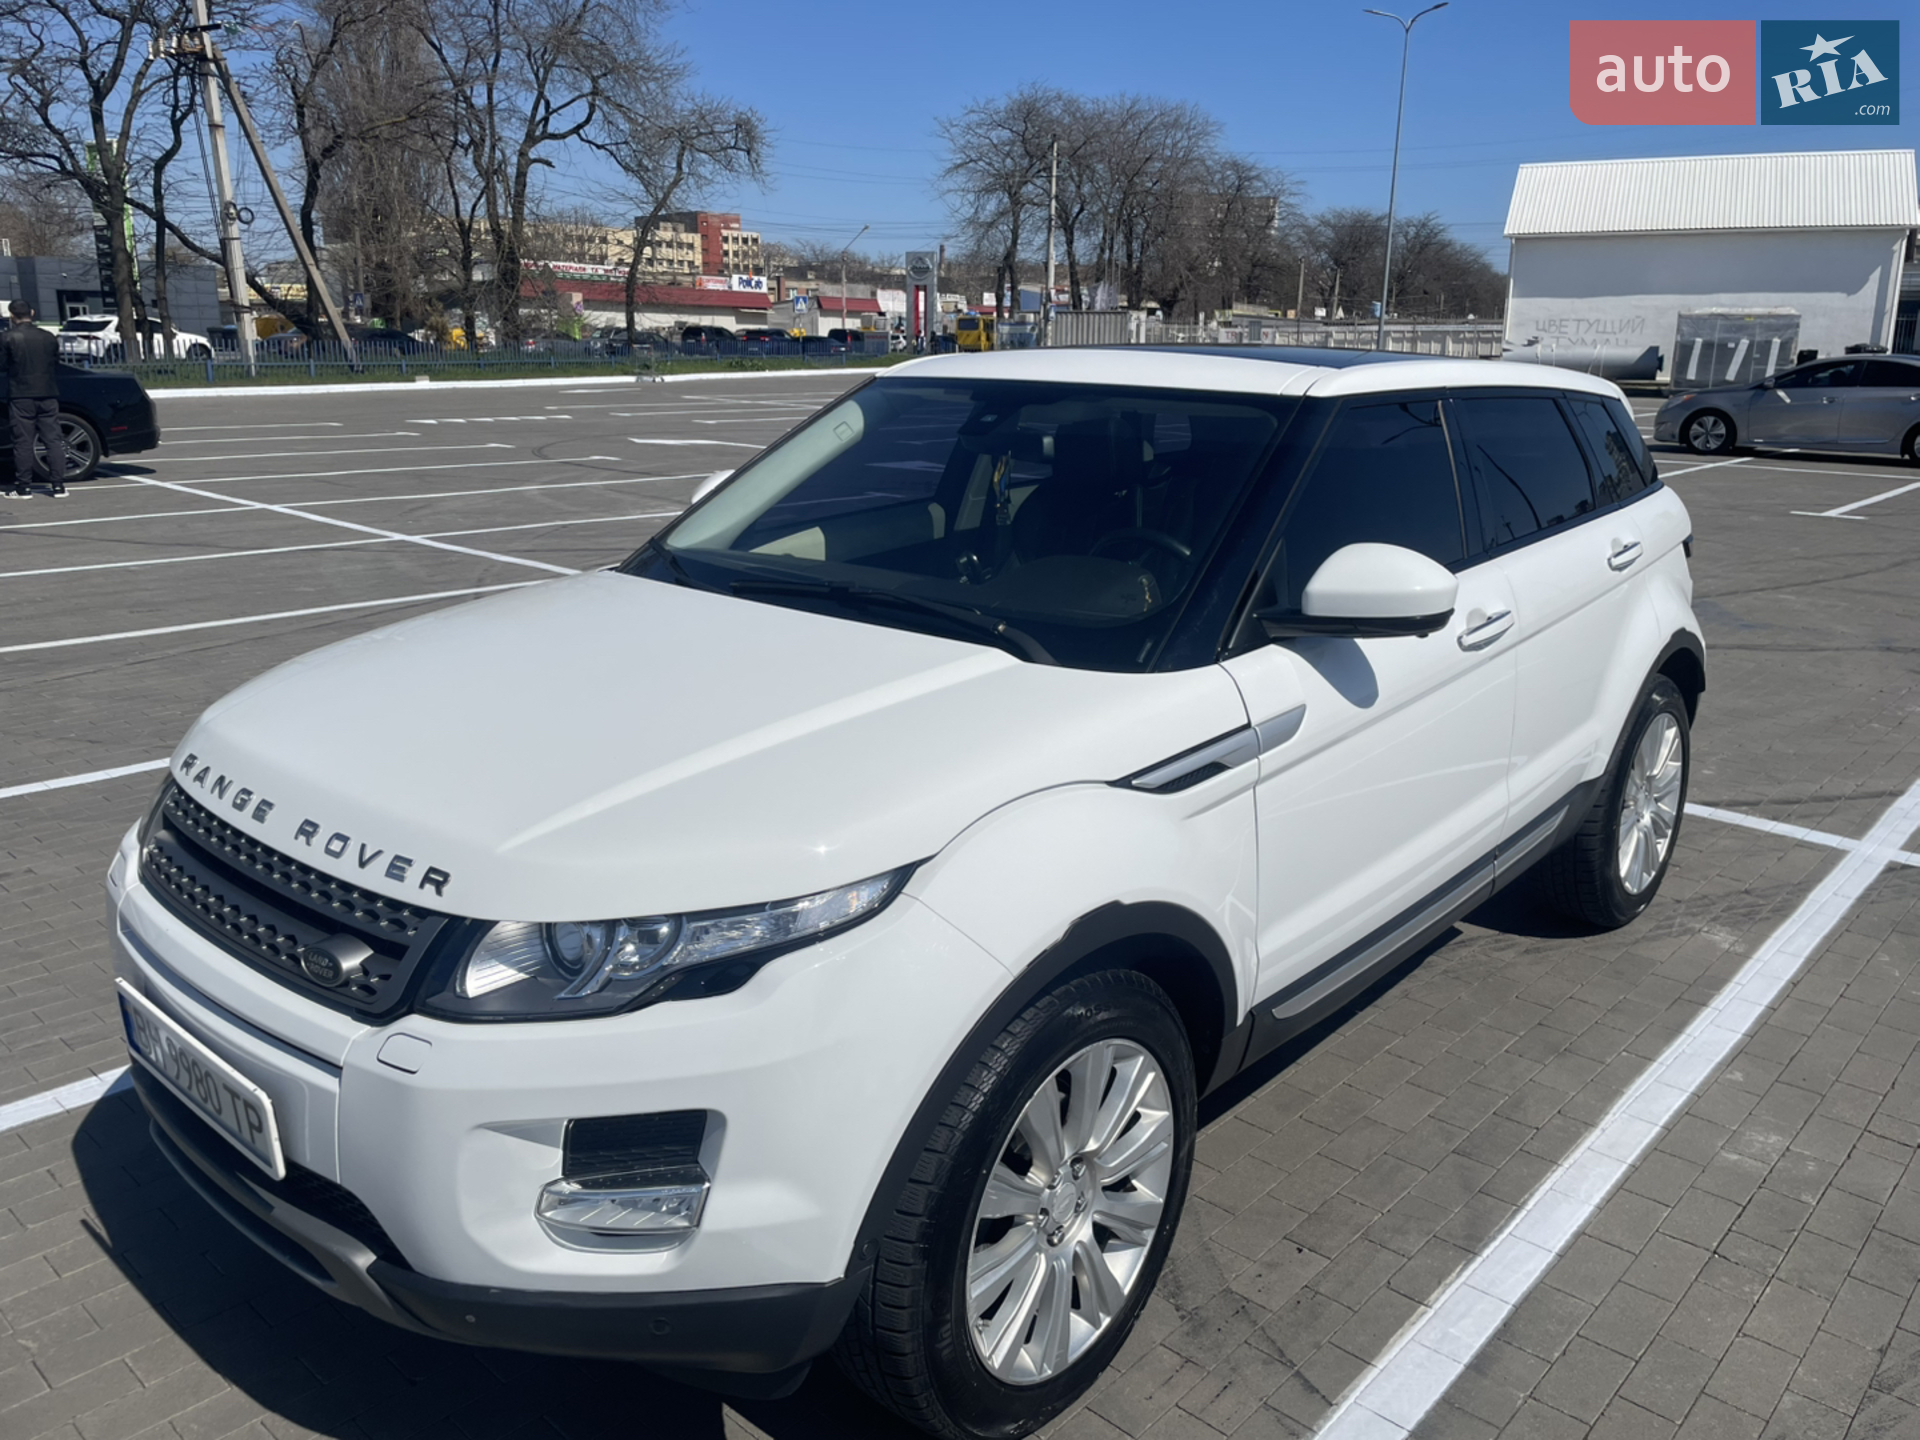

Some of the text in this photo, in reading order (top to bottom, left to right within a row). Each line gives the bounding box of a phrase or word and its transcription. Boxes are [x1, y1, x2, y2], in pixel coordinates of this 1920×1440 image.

[1535, 315, 1645, 335] ЦВЕТУЩИЙ
[179, 752, 452, 898] RANGE ROVER
[308, 951, 330, 967] LAND
[132, 1005, 264, 1146] BH 9980 TP
